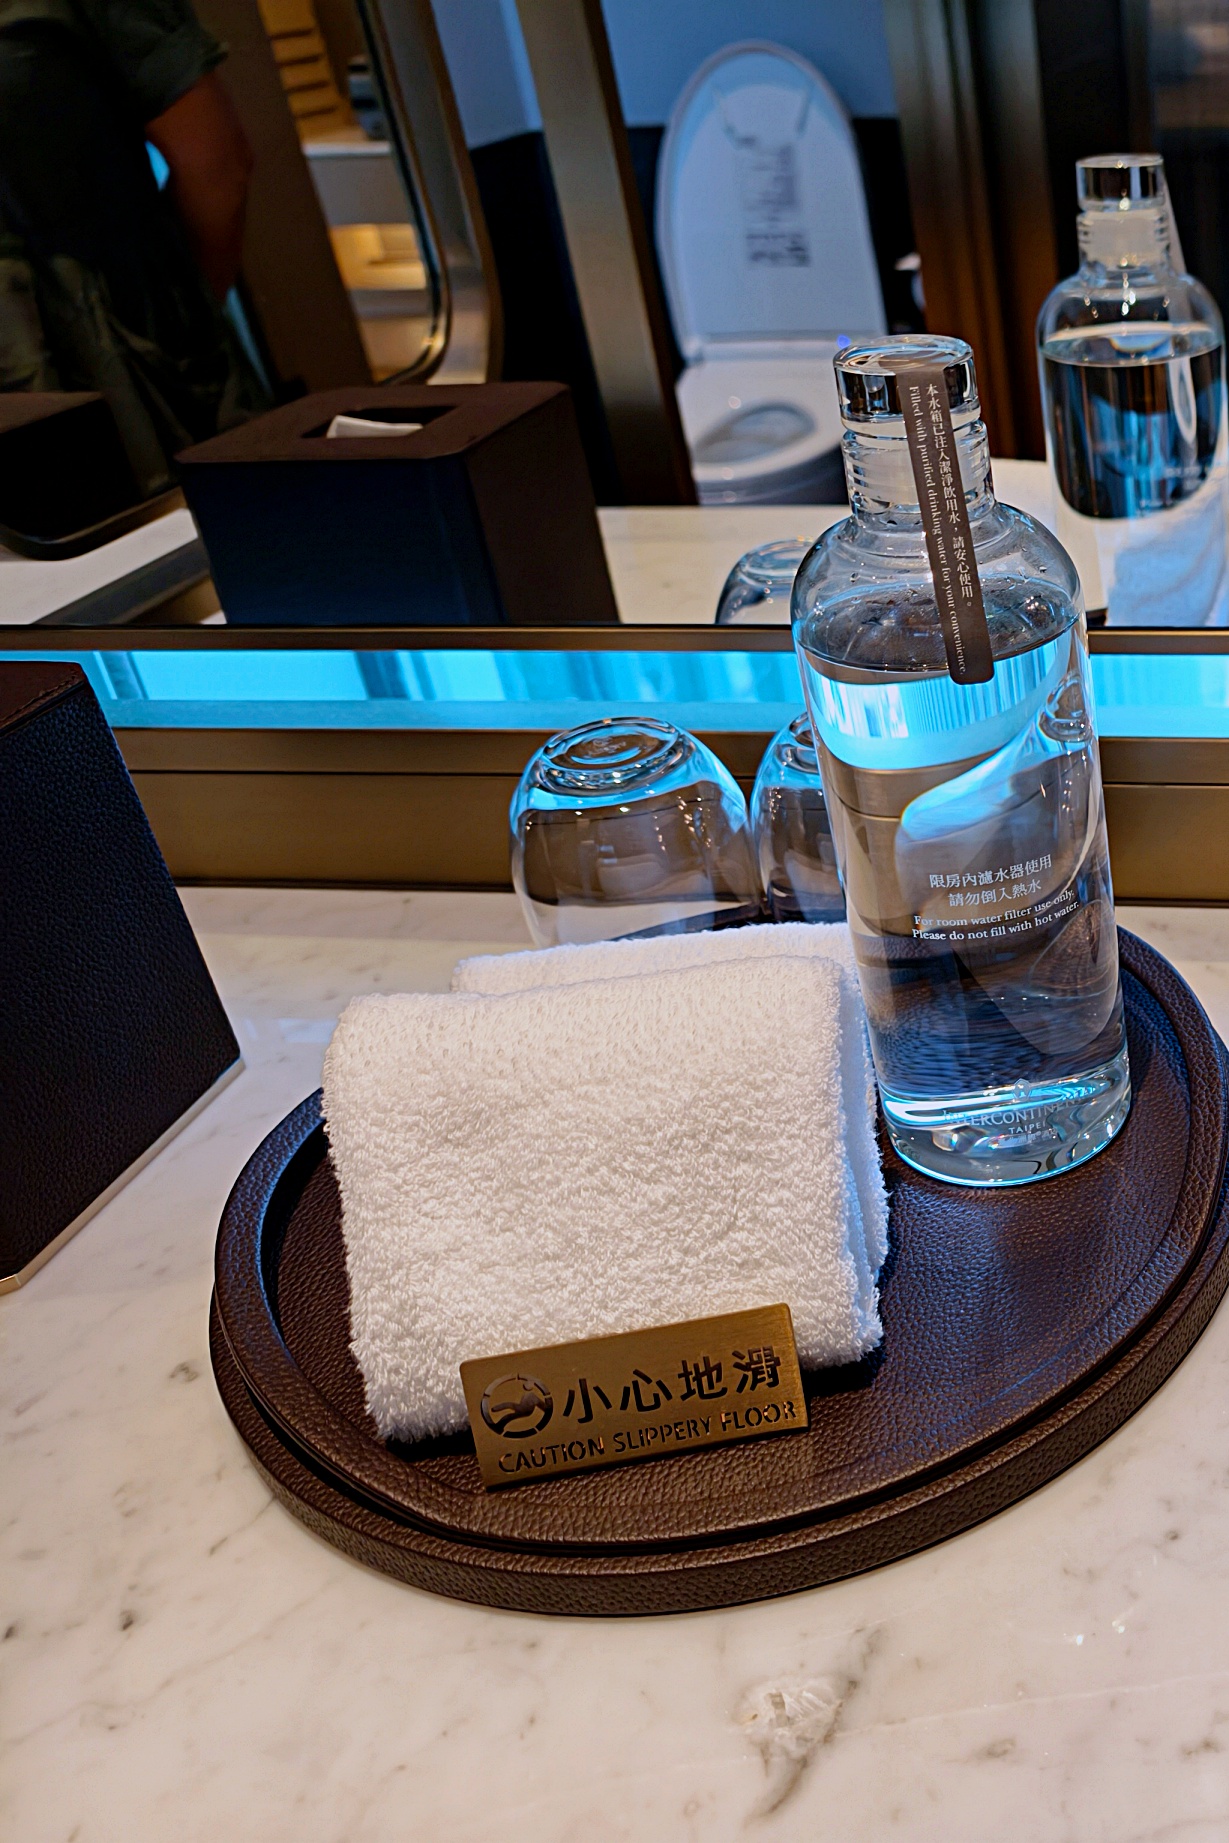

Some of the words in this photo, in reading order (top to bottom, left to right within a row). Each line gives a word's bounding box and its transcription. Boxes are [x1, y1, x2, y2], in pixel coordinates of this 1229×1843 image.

[909, 386, 924, 417] Filled
[915, 419, 928, 443] with
[917, 444, 936, 487] purified
[928, 489, 942, 535] drinking
[936, 537, 948, 565] water
[942, 567, 951, 583] for
[943, 583, 956, 609] your
[950, 610, 967, 675] convenience.
[914, 915, 933, 926] For
[936, 918, 968, 926] room
[971, 914, 1002, 925] water
[1004, 907, 1032, 921] filter
[1034, 901, 1051, 912] use
[1053, 889, 1075, 905] only.
[948, 879, 1042, 907] 請勿倒入熱水
[912, 928, 946, 940] Please
[949, 930, 964, 940] do
[967, 930, 989, 940] not
[990, 926, 1006, 937] fill
[1008, 921, 1033, 934] with
[1035, 915, 1053, 929] hot
[1054, 900, 1079, 919] water.
[1008, 1120, 1046, 1134] TAIPEI
[563, 1346, 781, 1423] 小心地滑
[498, 1437, 605, 1473] CAUTION
[615, 1416, 712, 1453] SLIPPERY
[721, 1400, 797, 1432] FLOOR
